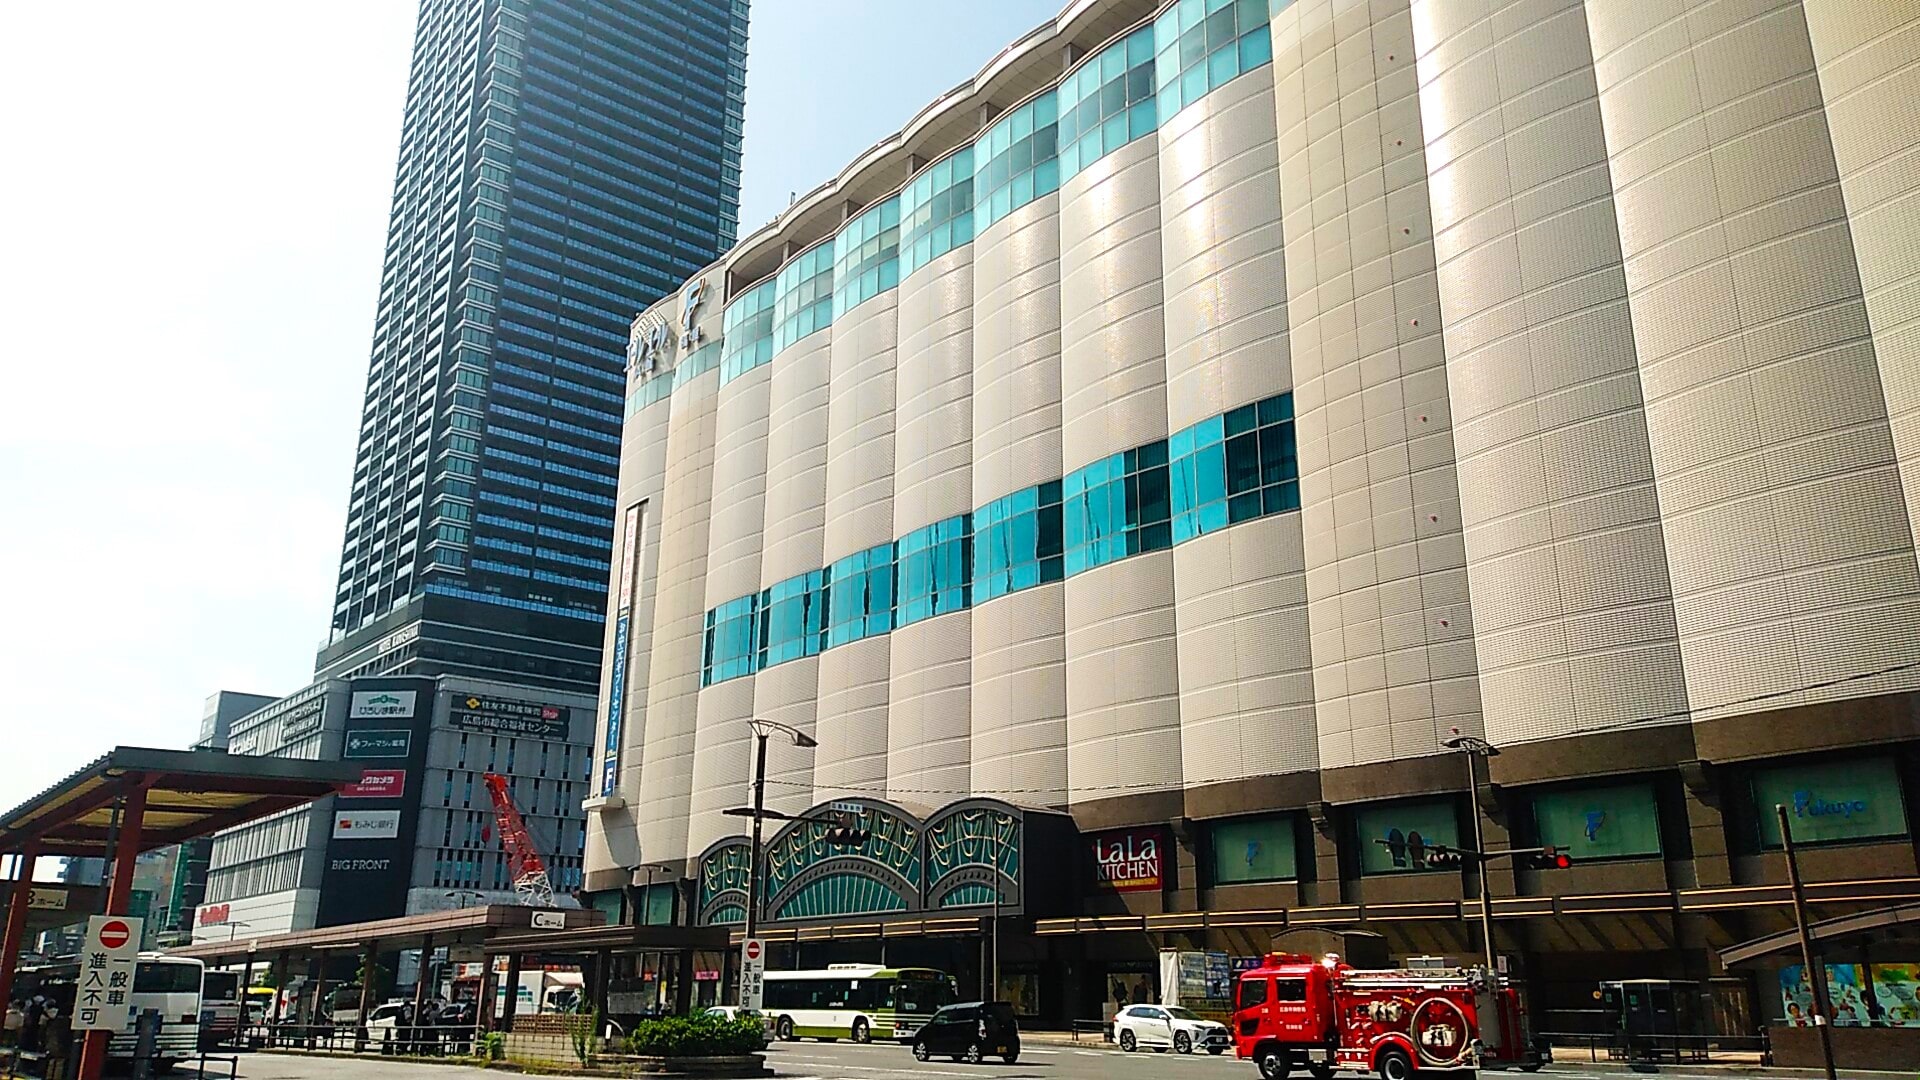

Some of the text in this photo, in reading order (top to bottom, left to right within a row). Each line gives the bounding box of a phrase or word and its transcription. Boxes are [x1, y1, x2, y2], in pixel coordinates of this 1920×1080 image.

[359, 706, 406, 715] ひろしま駅弁
[462, 715, 559, 733] 広島市総合福祉センター
[355, 820, 394, 829] もみじ銀行
[331, 859, 390, 870] BIG FRONT
[1096, 860, 1158, 881] KITCHEN
[80, 952, 107, 1025] 進入不可
[105, 956, 131, 1007] 一般車
[742, 961, 752, 1008] 進入不可
[752, 964, 762, 995] 一般車
